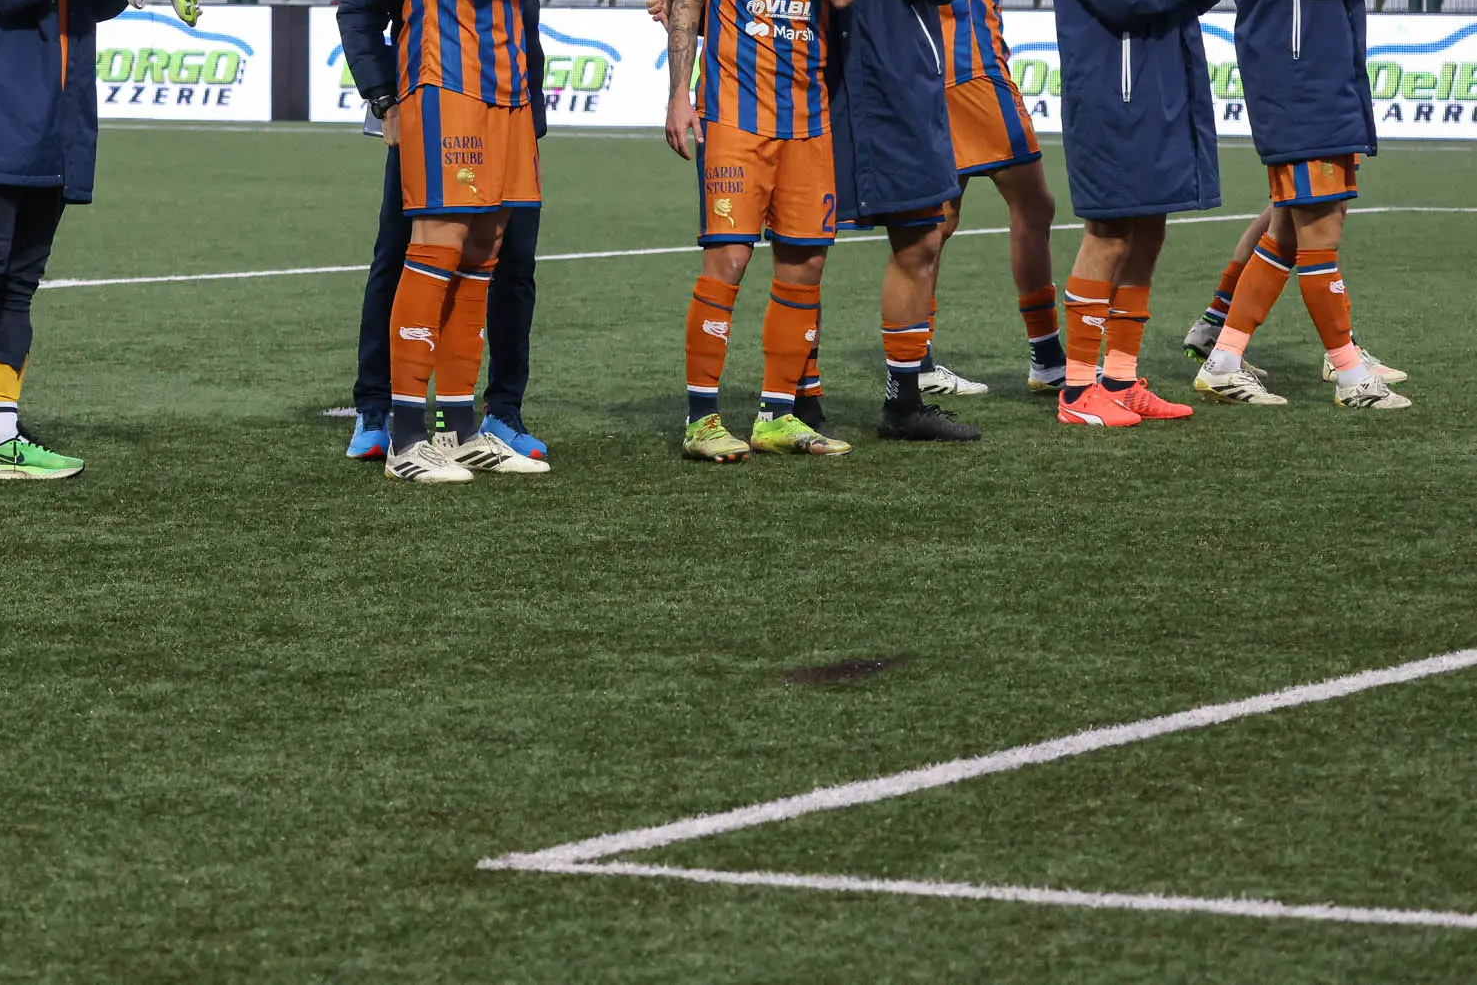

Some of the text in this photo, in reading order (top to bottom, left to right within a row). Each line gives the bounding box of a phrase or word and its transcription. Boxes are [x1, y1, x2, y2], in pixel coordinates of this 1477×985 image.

[773, 24, 815, 42] Marsh
[441, 135, 484, 149] GARDA
[444, 150, 484, 165] STUBE
[705, 166, 745, 179] GARDA
[706, 180, 744, 194] STUBE
[821, 193, 836, 233] 2
